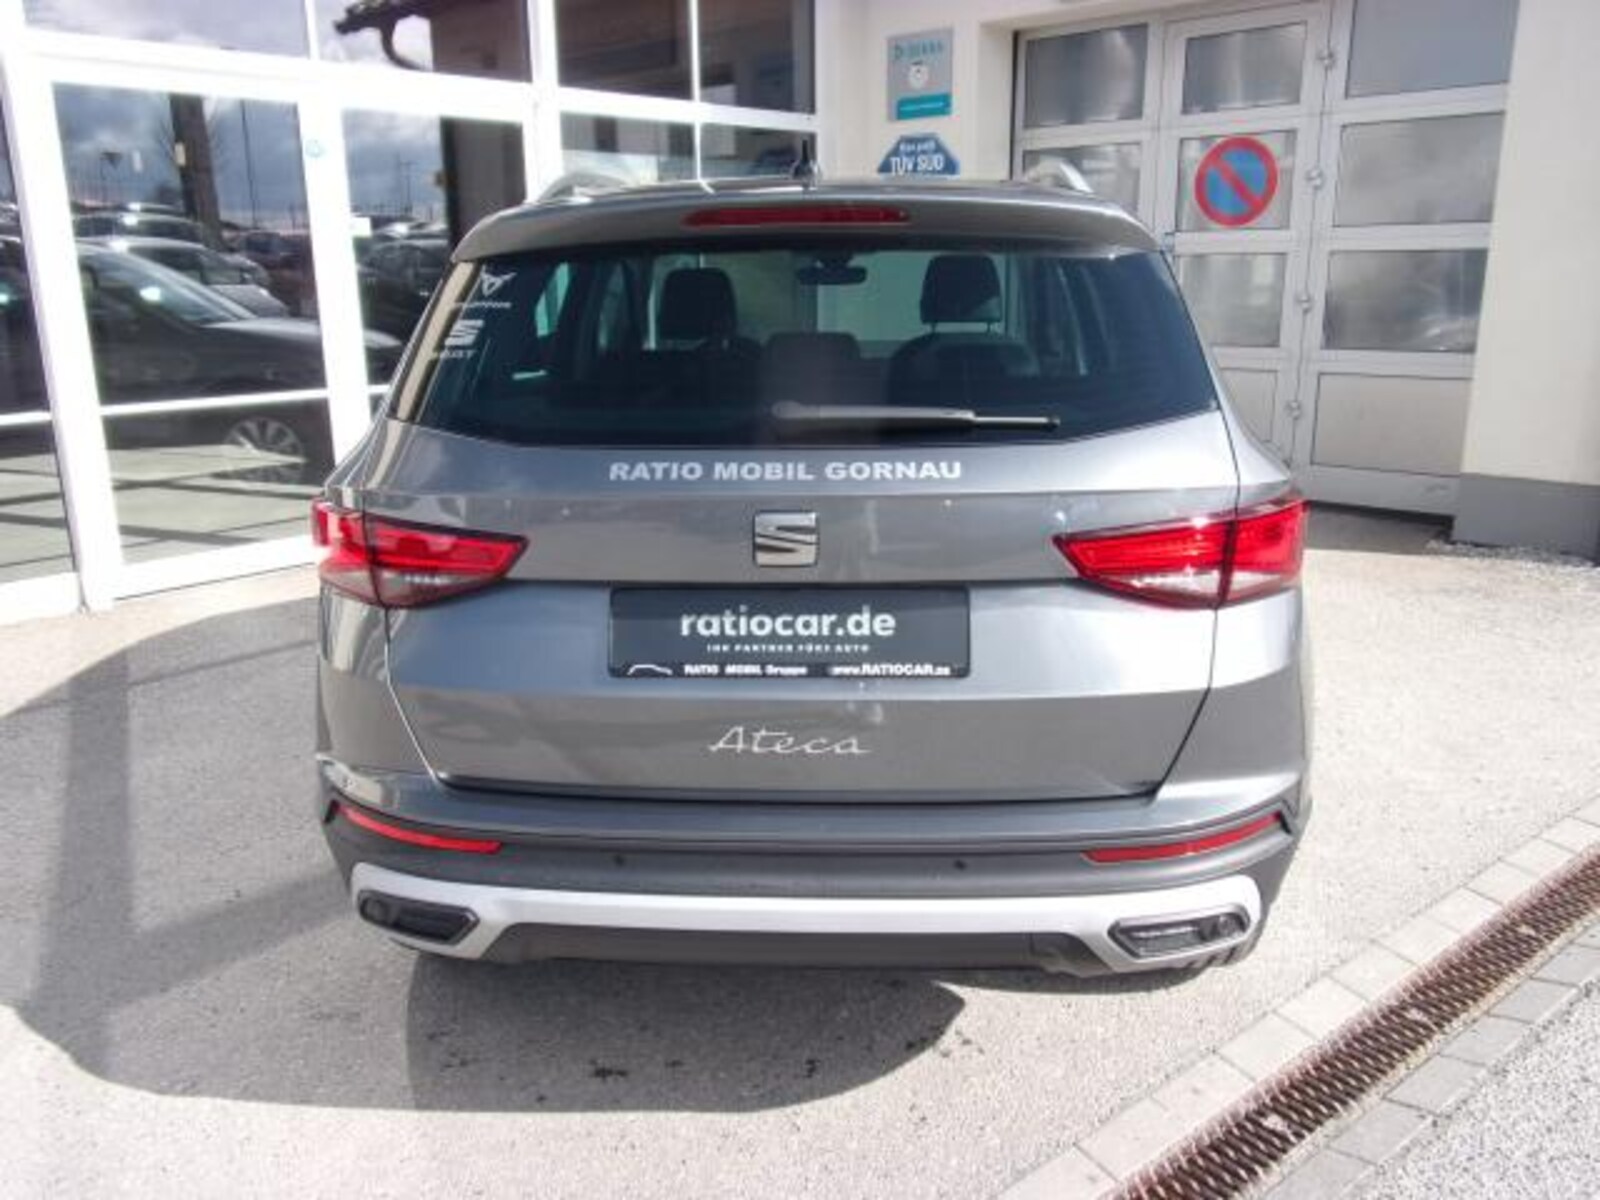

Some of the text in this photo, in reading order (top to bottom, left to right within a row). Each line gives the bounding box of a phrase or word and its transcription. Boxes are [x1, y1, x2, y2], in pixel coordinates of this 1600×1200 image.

[609, 460, 963, 481] RATIO MOBIL GORNAU
[680, 604, 897, 637] ratiocar.de
[708, 726, 871, 753] Ateca
